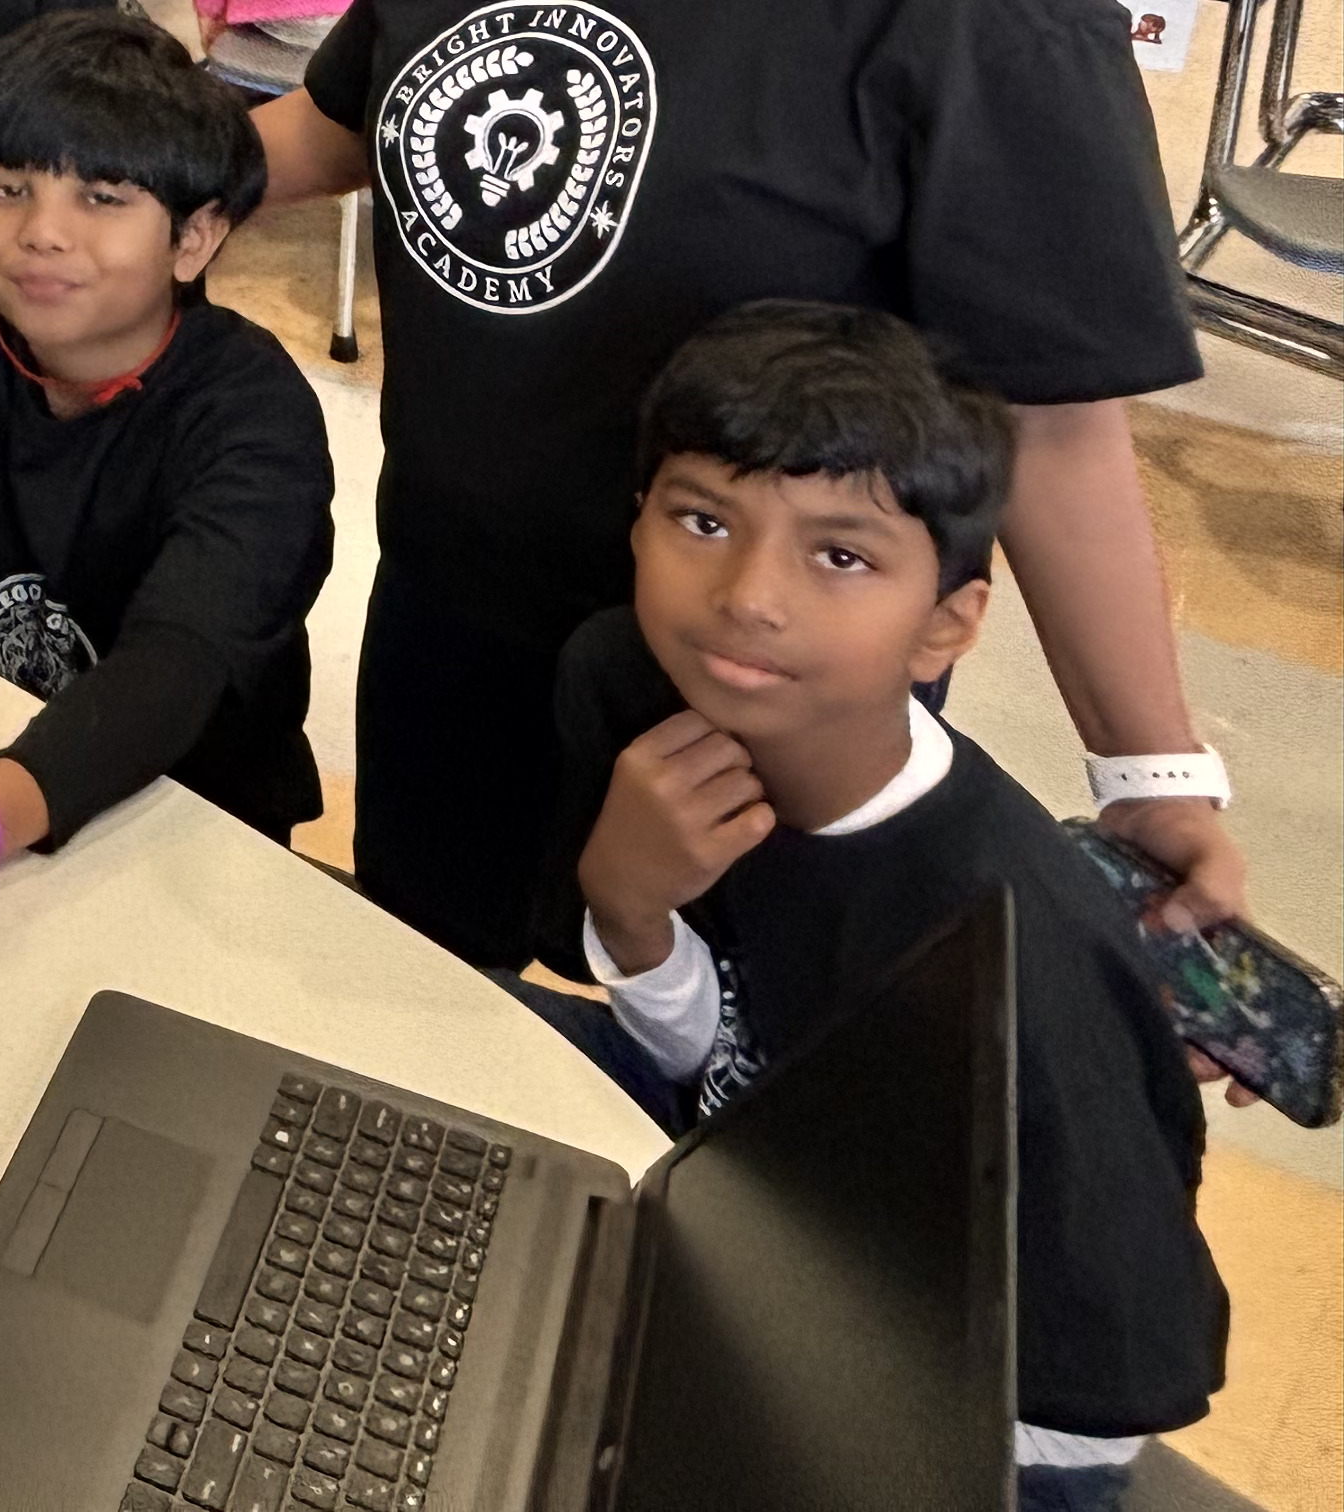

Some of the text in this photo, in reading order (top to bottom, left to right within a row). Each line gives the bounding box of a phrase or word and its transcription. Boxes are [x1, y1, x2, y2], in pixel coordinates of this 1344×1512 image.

[396, 8, 644, 189] BRIGHT INNOVATORS
[401, 210, 557, 303] ACADEMY
